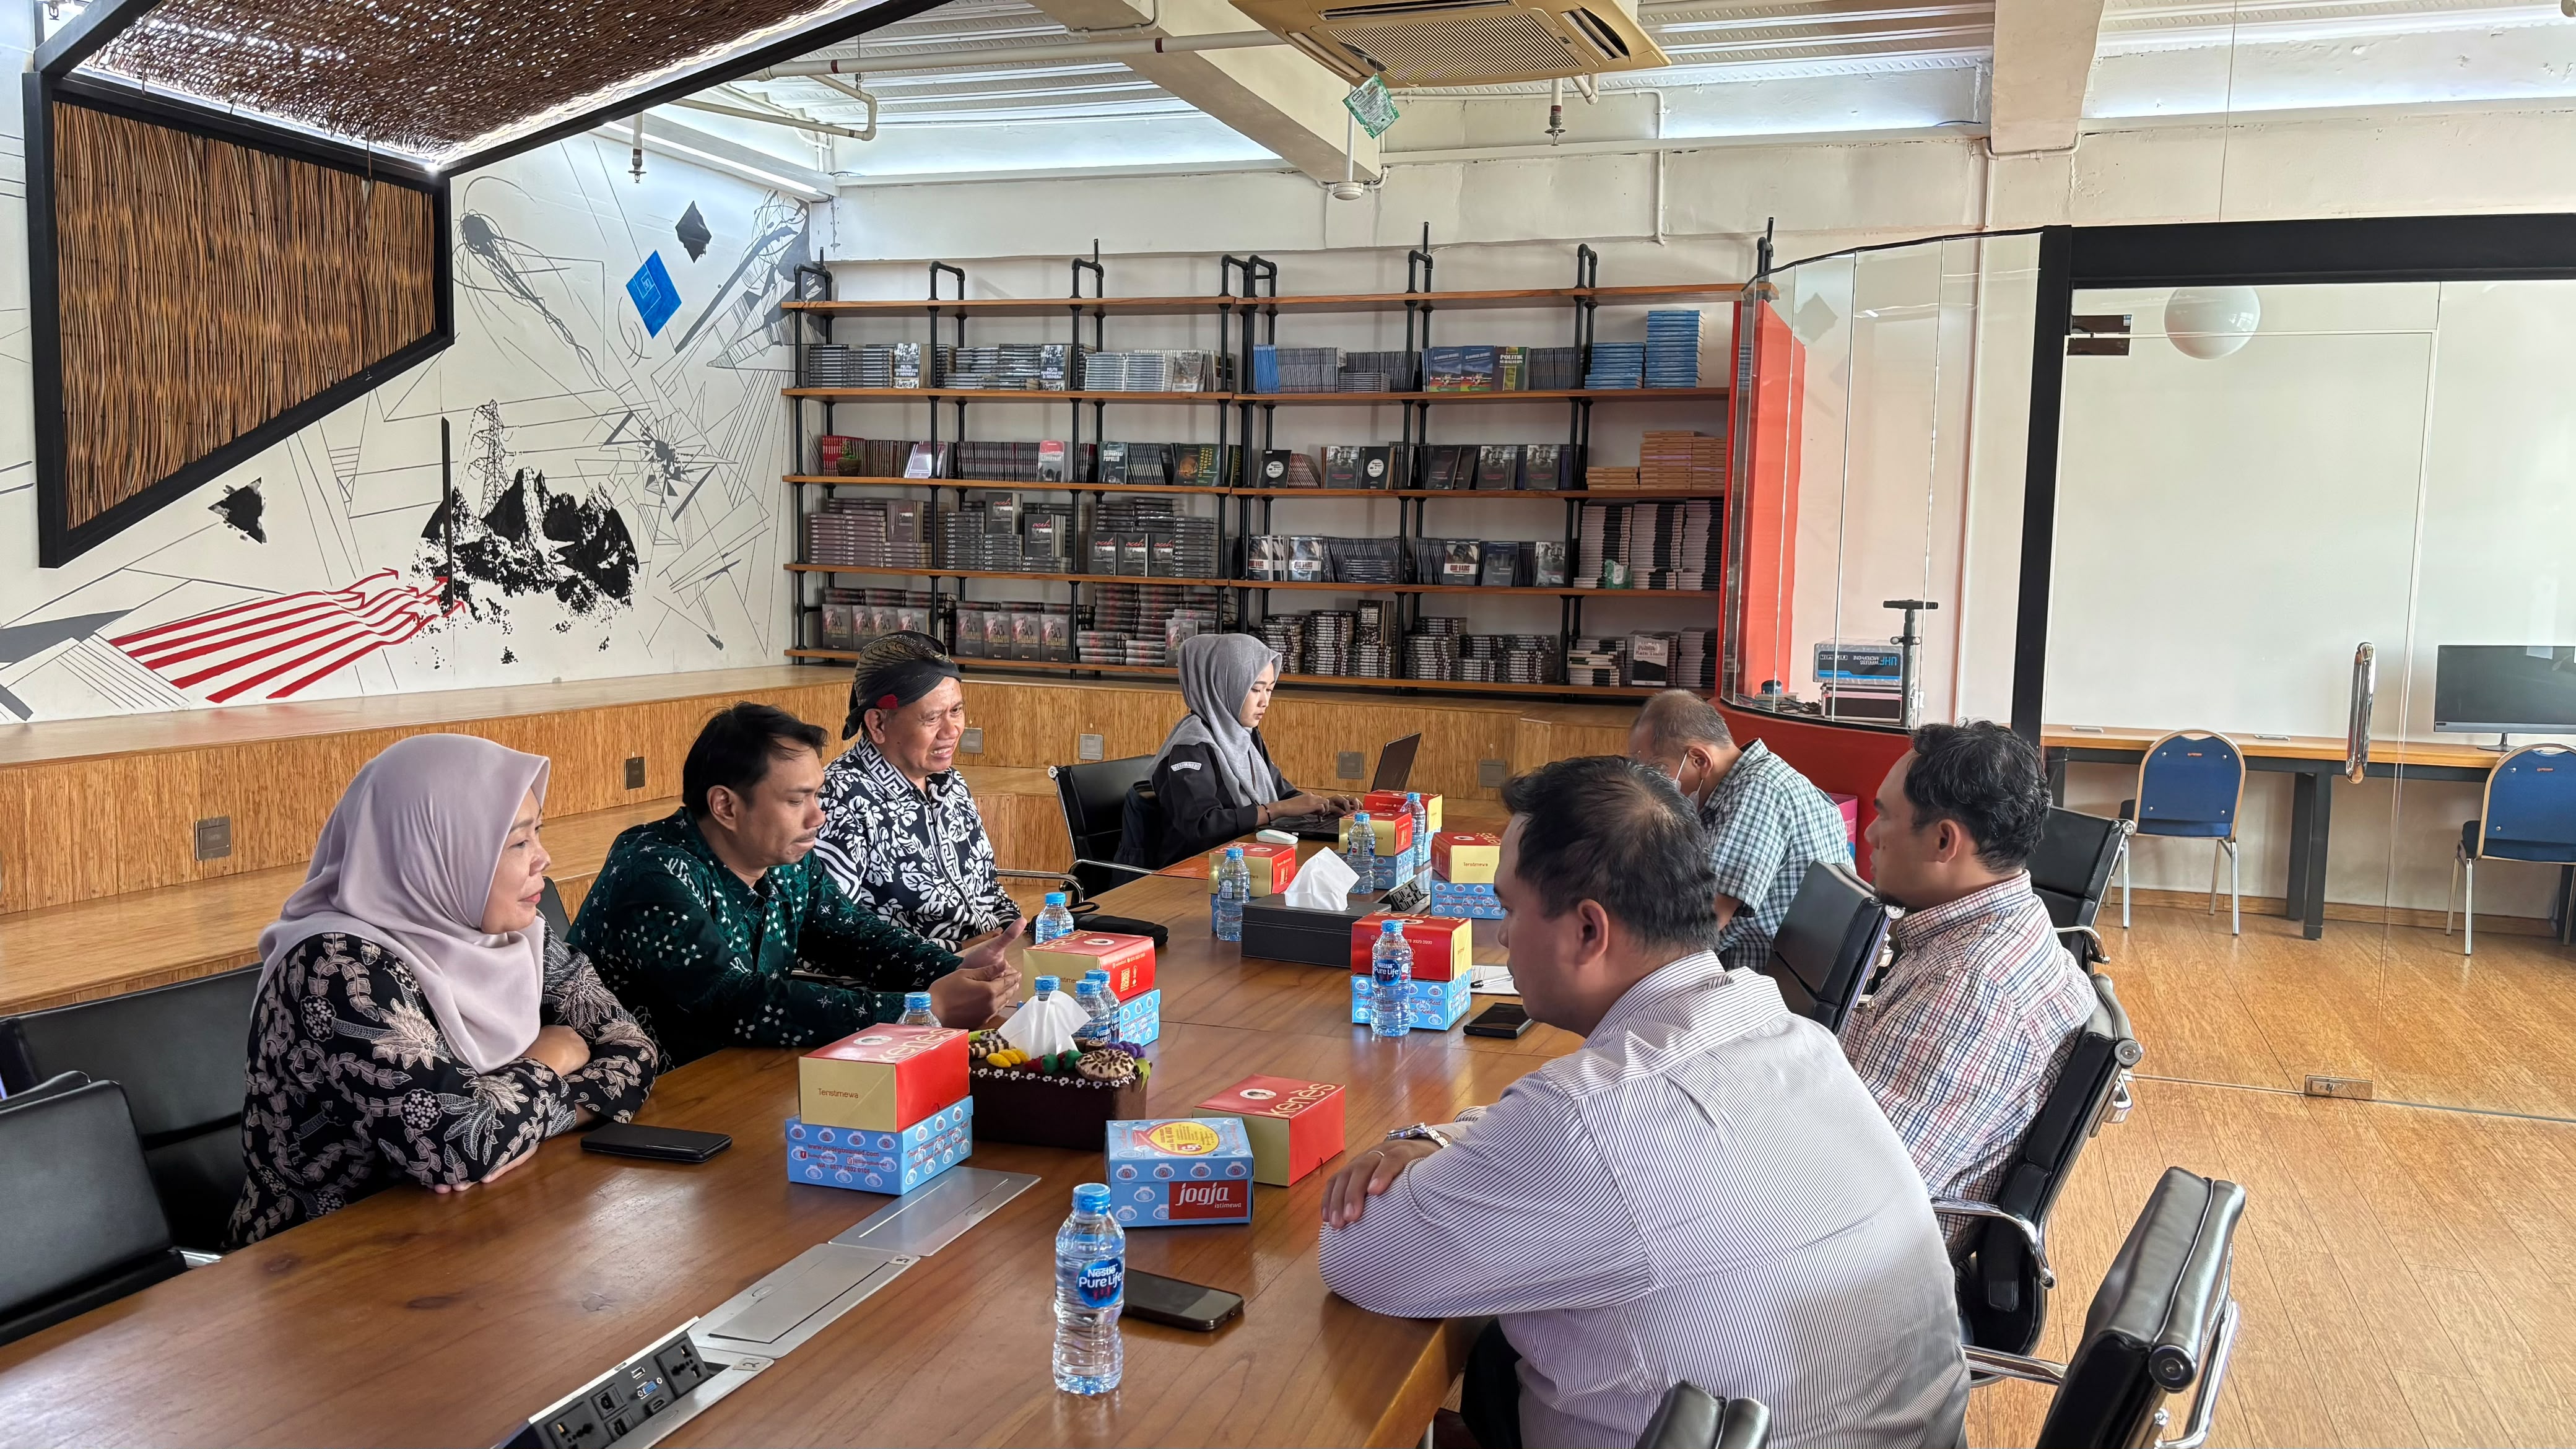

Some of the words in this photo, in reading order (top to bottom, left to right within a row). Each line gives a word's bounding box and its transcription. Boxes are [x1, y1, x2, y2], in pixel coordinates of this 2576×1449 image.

[1880, 656, 1897, 666] UHF
[1374, 967, 1386, 975] Pure
[1387, 968, 1399, 977] Life
[1175, 1182, 1230, 1206] jogja
[1087, 1264, 1117, 1277] Nestlé
[1079, 1277, 1107, 1288] Pure
[1108, 1271, 1122, 1288] Life
